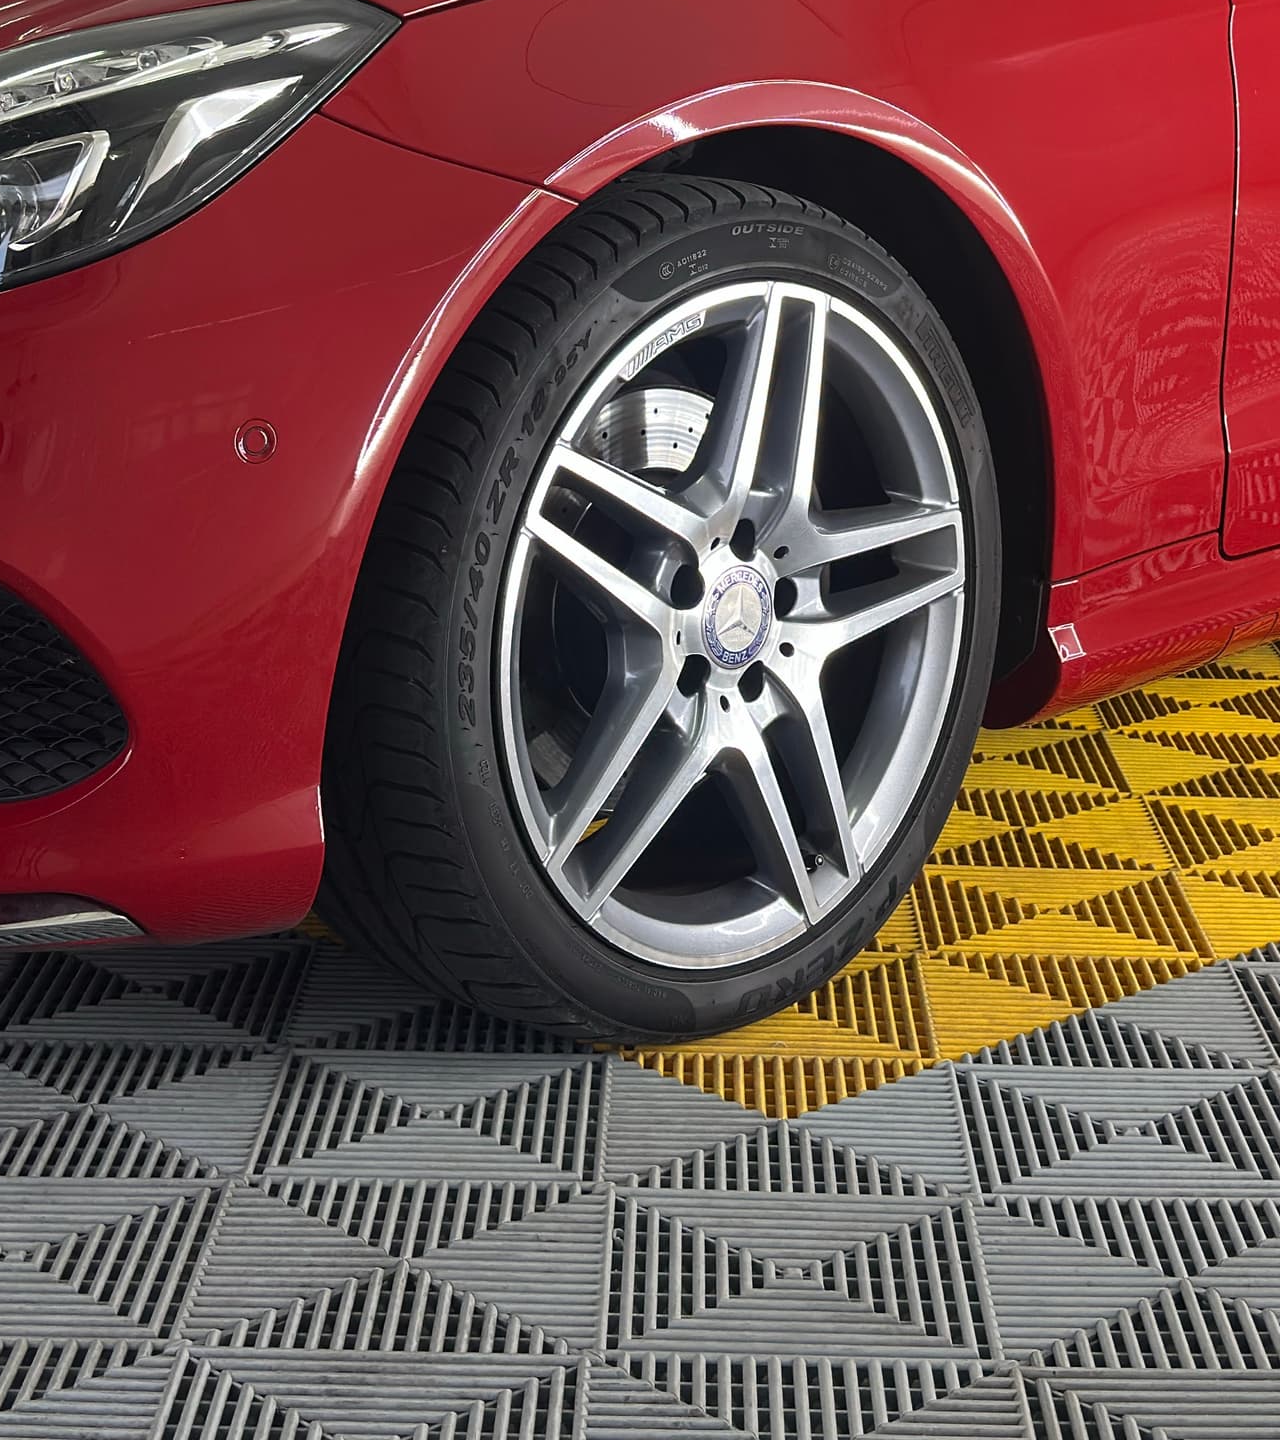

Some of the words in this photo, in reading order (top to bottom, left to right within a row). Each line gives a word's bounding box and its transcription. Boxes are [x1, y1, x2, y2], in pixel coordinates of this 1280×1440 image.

[731, 222, 805, 236] OUTSIDE
[458, 531, 491, 727] 235/40
[487, 446, 520, 525] ZR
[722, 649, 749, 664] BENZ
